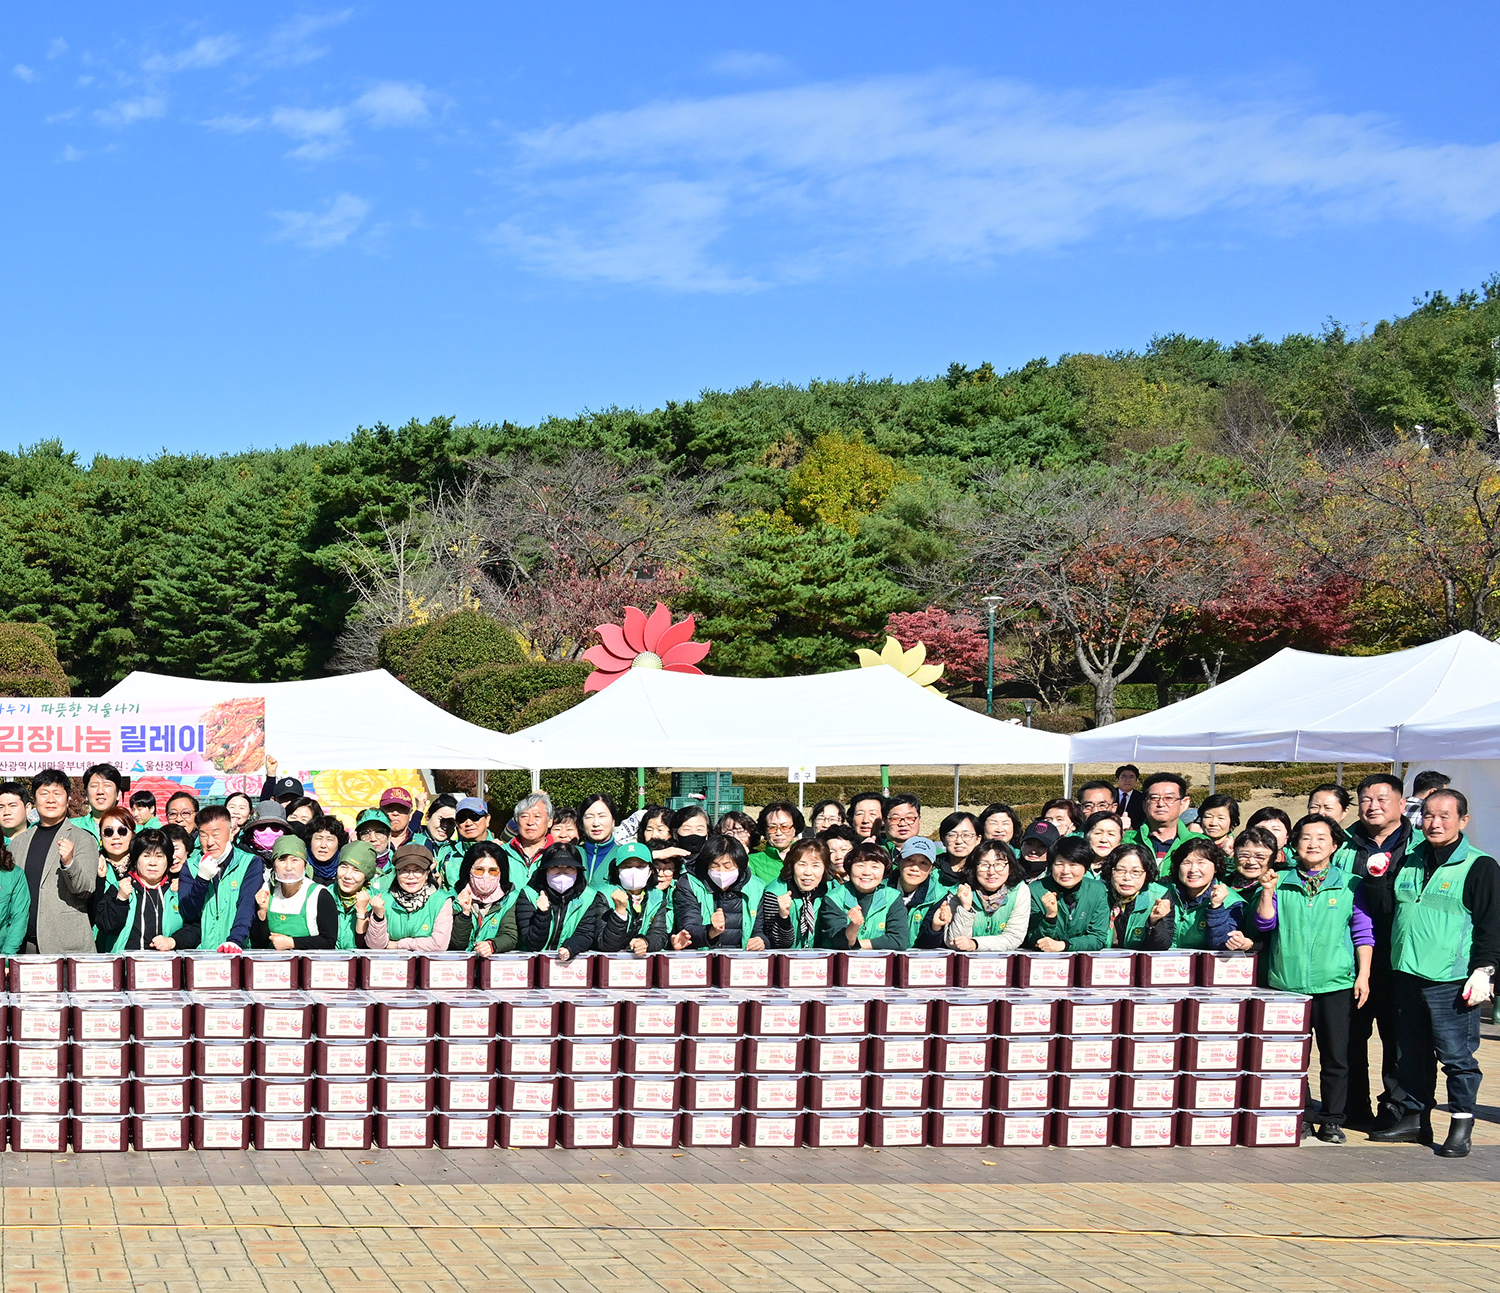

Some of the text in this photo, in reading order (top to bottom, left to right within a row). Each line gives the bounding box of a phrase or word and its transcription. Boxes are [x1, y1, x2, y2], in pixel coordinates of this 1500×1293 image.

[41, 702, 82, 718] 따뜻한
[88, 703, 139, 718] 겨울나기
[0, 725, 111, 753] 김장나눔
[121, 725, 204, 753] 릴레이
[145, 760, 193, 772] 울산광역시
